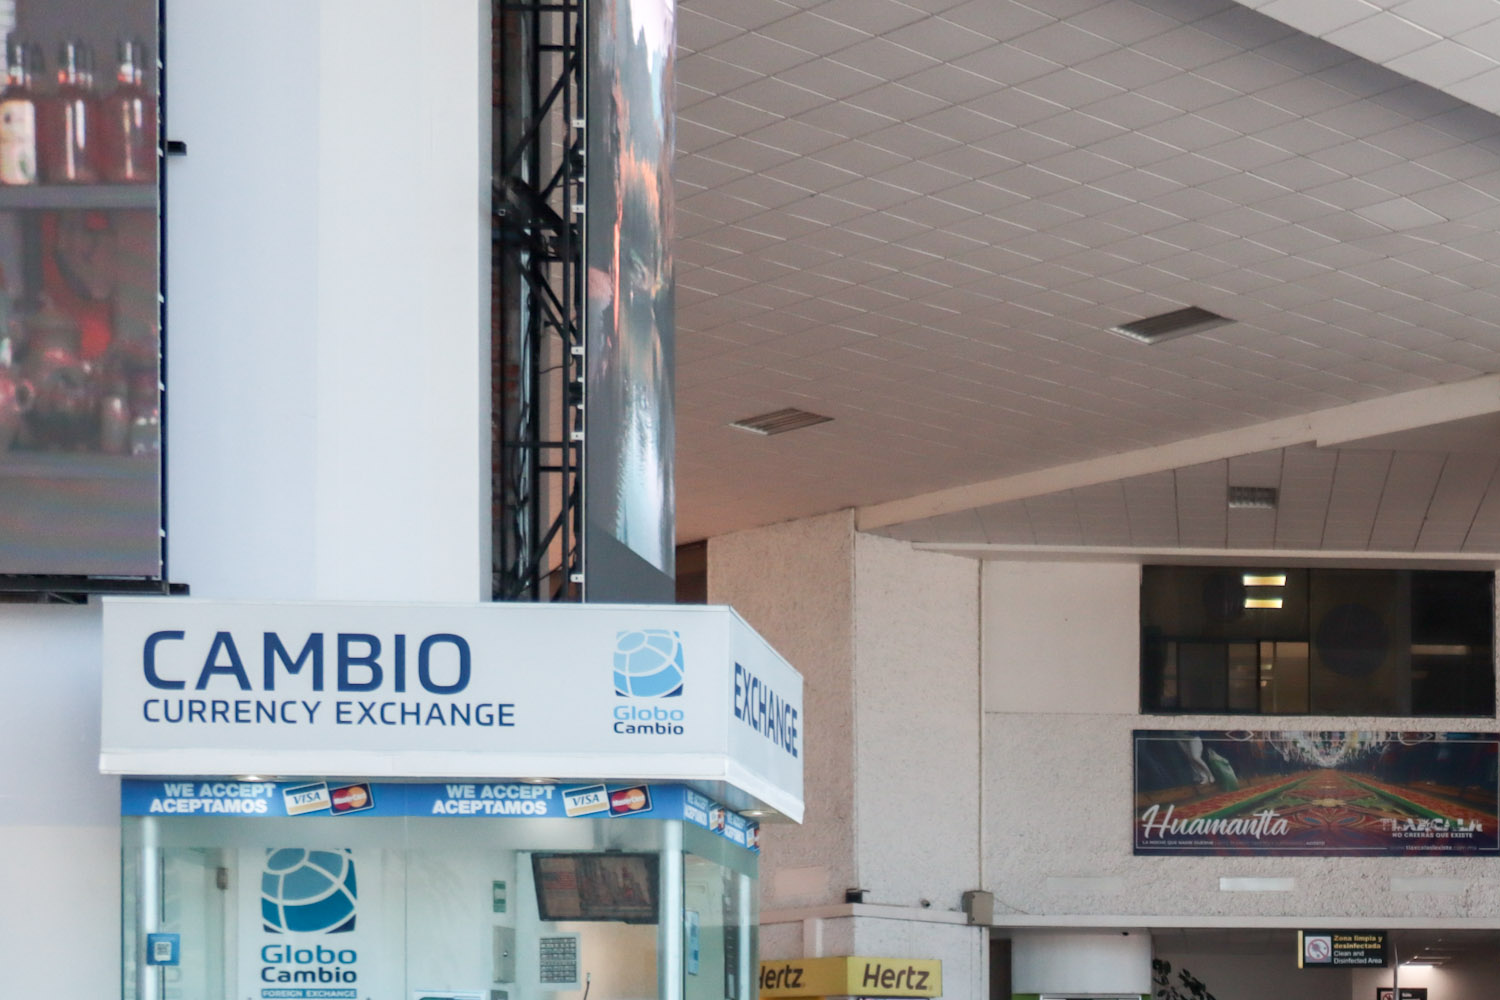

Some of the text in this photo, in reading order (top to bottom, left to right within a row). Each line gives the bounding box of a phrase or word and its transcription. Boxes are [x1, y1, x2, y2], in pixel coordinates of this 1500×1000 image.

[143, 630, 472, 695] CAMBIO
[143, 699, 516, 727] CURRENCY EXCHANGE
[613, 705, 684, 721] Globo
[734, 661, 798, 759] EXCHANGE
[613, 721, 684, 735] Cambio
[163, 783, 276, 798] WE ACCEPT
[293, 791, 321, 805] VISA
[446, 785, 556, 799] WE ACCEPT
[149, 797, 268, 814] ACEPTAMOS
[432, 799, 548, 815] ACEPTAMOS
[572, 793, 600, 807] VISA
[1141, 804, 1290, 841] Huamantla
[1354, 935, 1377, 943] limpia
[261, 944, 358, 965] Globo
[261, 966, 358, 983] Cambio
[862, 963, 931, 990] Hertz
